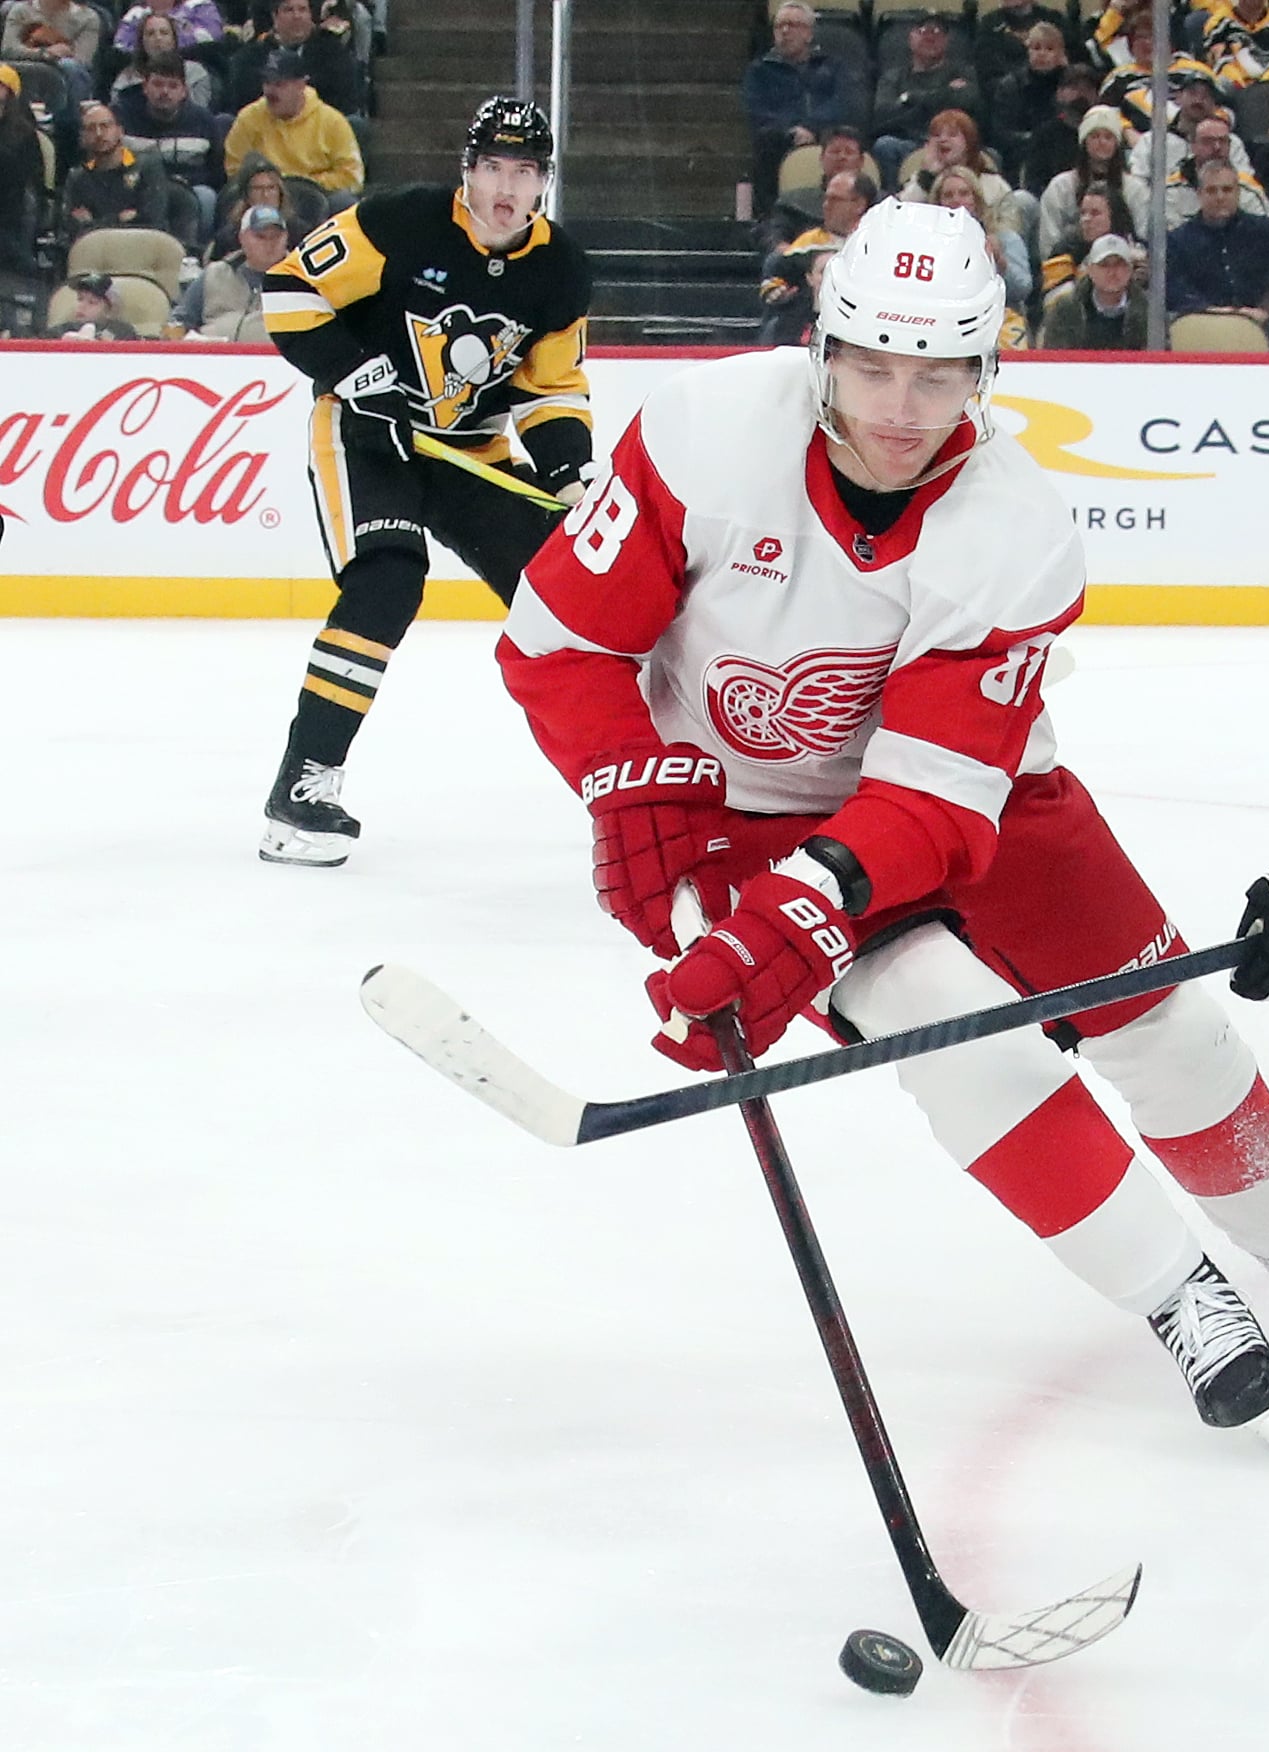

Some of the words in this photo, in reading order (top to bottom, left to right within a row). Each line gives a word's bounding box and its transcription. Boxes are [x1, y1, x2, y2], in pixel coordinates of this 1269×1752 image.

[502, 112, 521, 126] 10
[894, 252, 935, 282] 88
[876, 311, 936, 326] BAUER
[355, 518, 422, 537] BAUER
[731, 562, 788, 584] PRIORITY
[581, 756, 721, 806] BAUER
